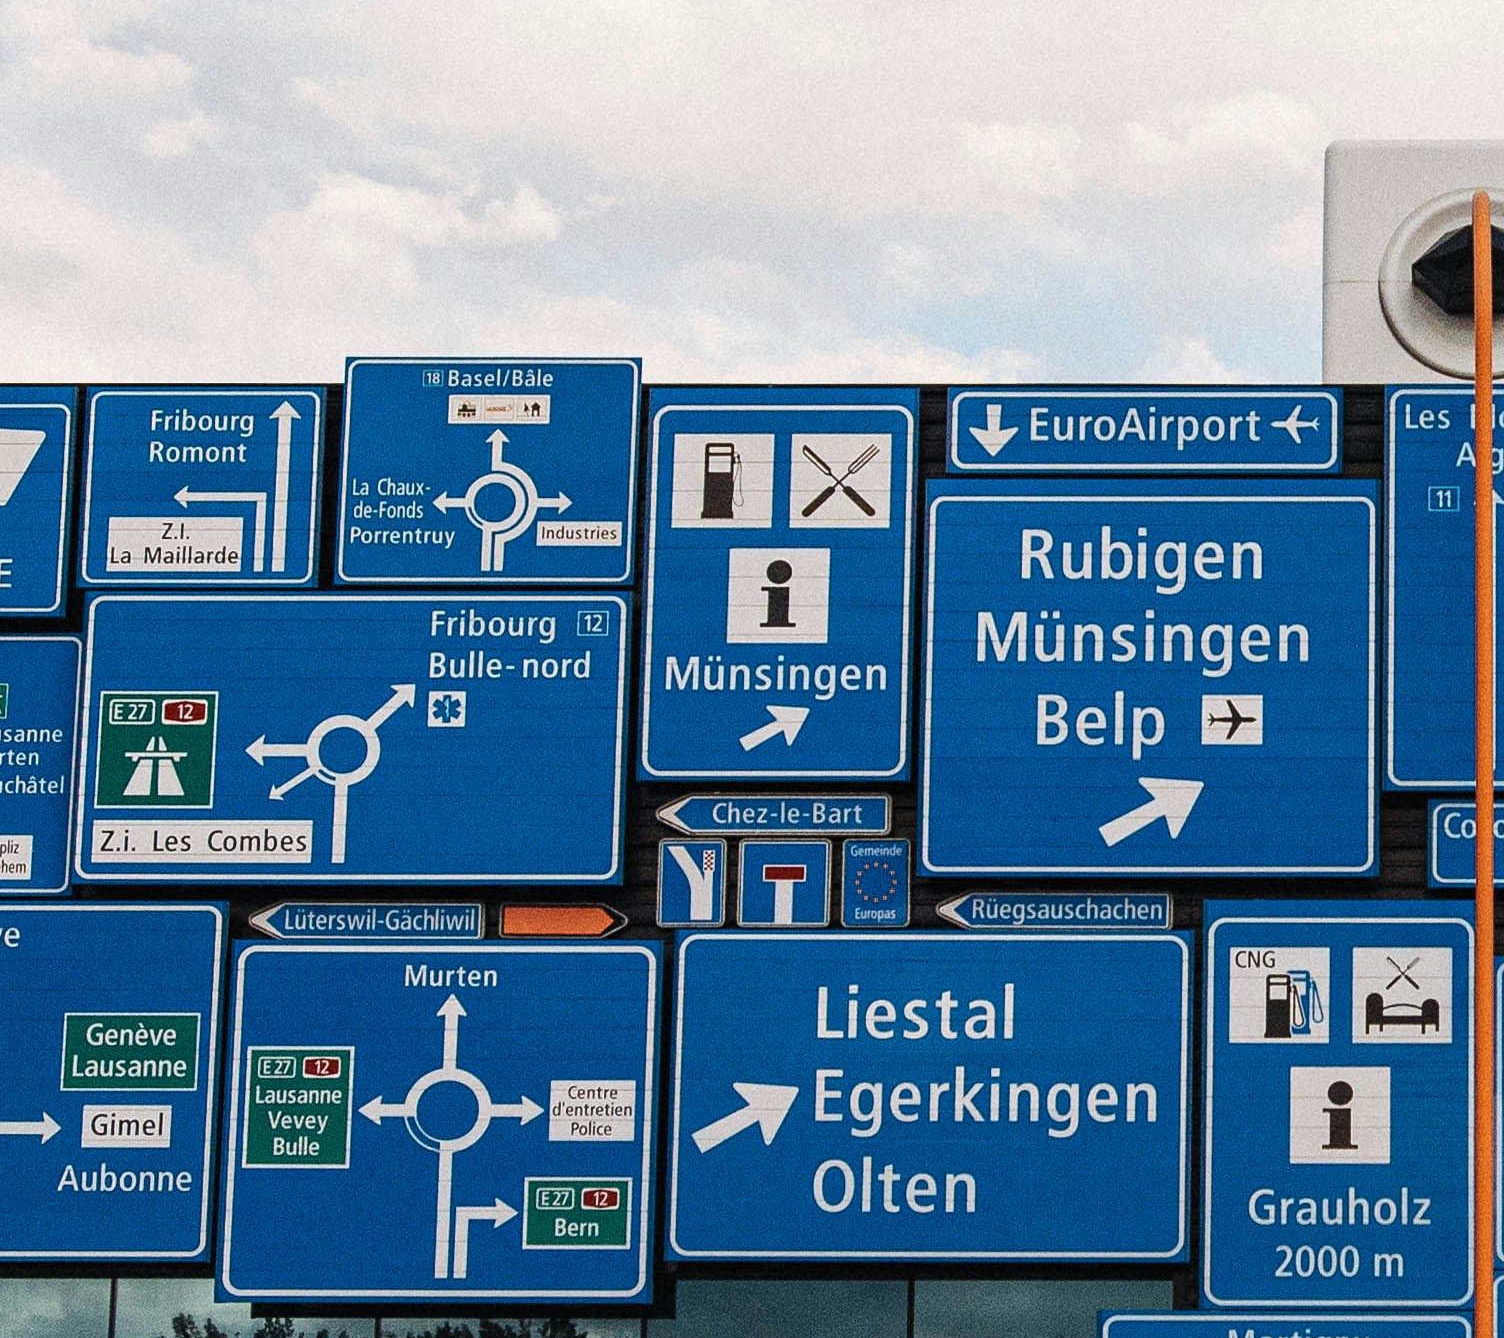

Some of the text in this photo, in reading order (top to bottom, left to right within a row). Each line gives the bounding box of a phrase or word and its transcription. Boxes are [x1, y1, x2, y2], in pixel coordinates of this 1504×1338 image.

[1030, 406, 1261, 451] EuroAirport
[352, 477, 431, 496] La Chaux-
[110, 545, 239, 565] La Maillarde
[430, 608, 603, 645] Fribourg 12
[1036, 690, 1165, 760] Belp
[712, 801, 863, 824] Chez-le-Bart
[971, 897, 1163, 921] Rüegsauschachen
[1234, 950, 1276, 969] CNG
[404, 964, 498, 987] Murten
[816, 982, 1015, 1040] Liestal
[86, 1022, 177, 1046] Genève
[272, 1135, 320, 1156] Bulle
[813, 1156, 976, 1213] Olten
[554, 1217, 600, 1237] Bern
[1274, 1245, 1404, 1278] 2000 m
